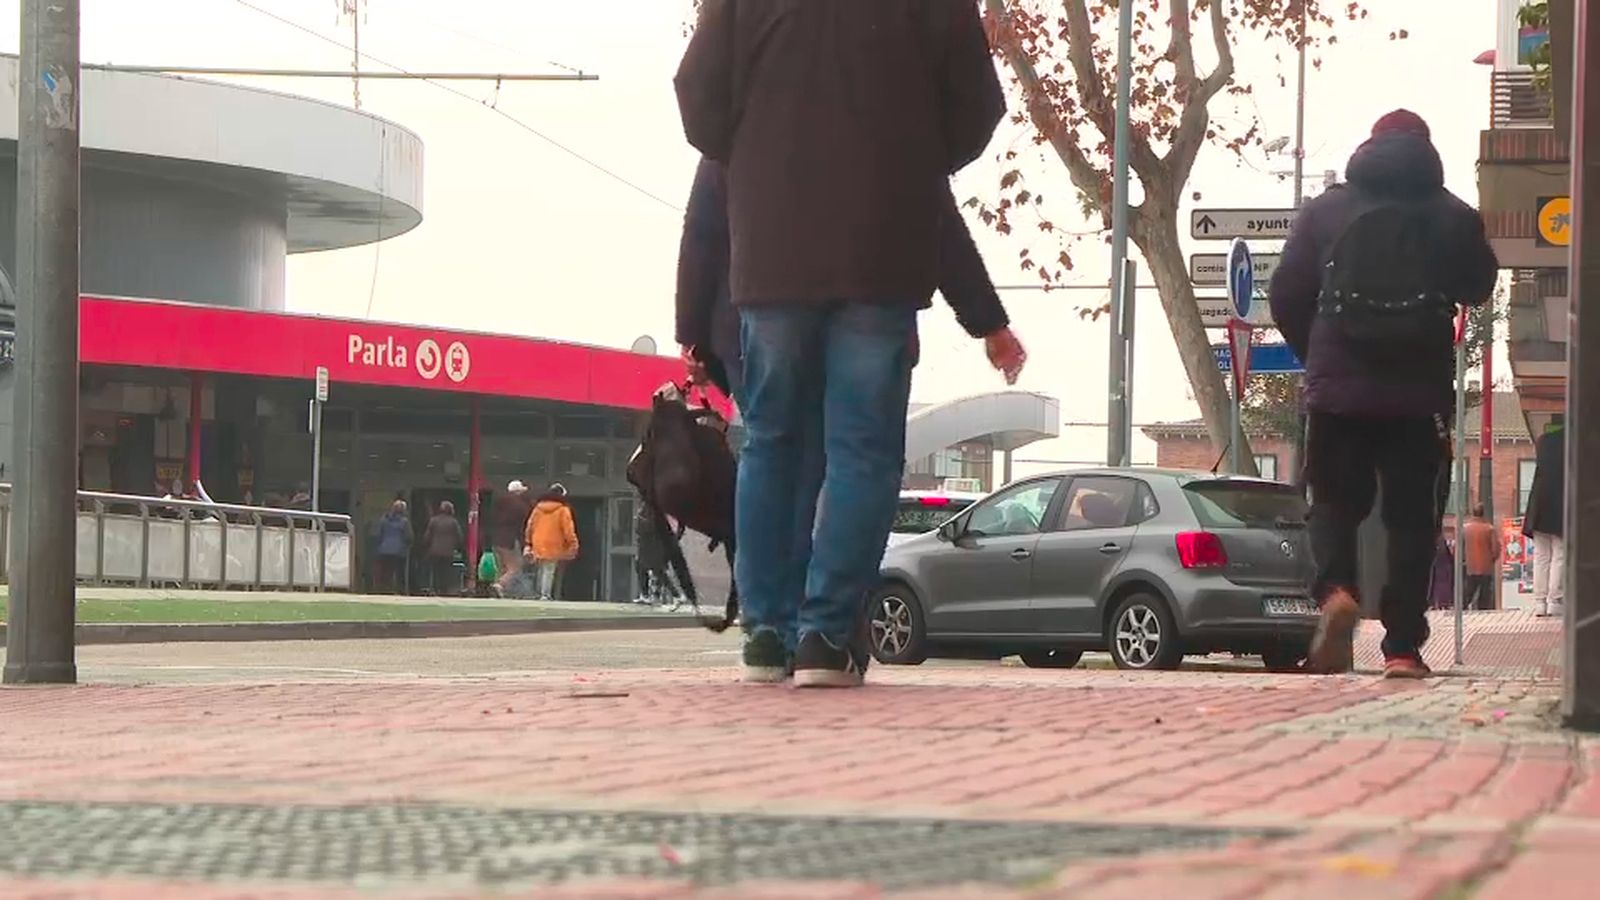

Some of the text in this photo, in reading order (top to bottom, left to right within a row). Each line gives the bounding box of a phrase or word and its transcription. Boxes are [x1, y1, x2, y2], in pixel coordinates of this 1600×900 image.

[1196, 264, 1227, 272] comis
[1200, 308, 1234, 317] uzgado
[347, 334, 408, 368] Parla
